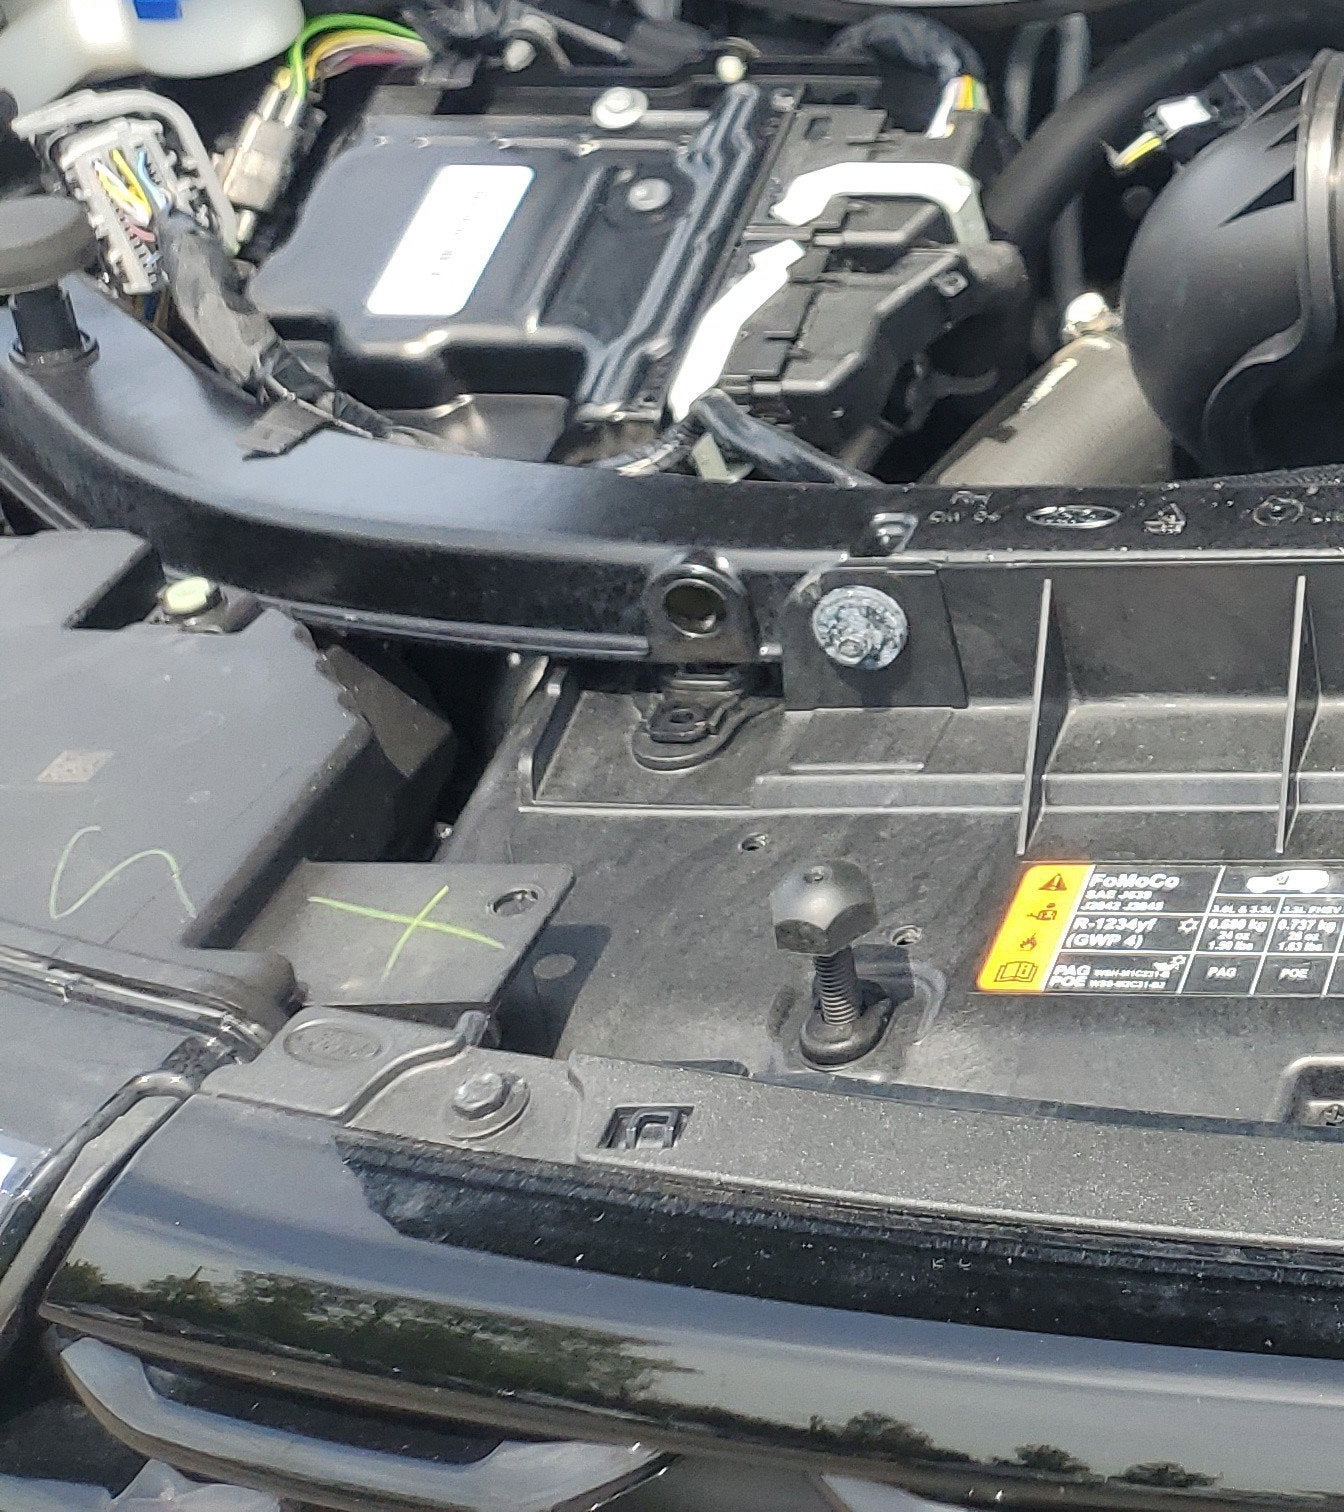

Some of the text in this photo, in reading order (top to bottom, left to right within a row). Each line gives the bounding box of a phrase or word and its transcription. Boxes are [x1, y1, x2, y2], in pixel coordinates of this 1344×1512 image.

[1088, 874, 1180, 889] FoMoCo
[1073, 917, 1158, 933] R-1234yf
[1248, 919, 1267, 933] kg
[1318, 919, 1336, 934] kg
[1065, 934, 1143, 949] (GWP 4)
[1053, 965, 1091, 976] PAG
[1207, 967, 1237, 978] PAG
[1280, 968, 1310, 979] POE
[1050, 976, 1087, 987] POE
